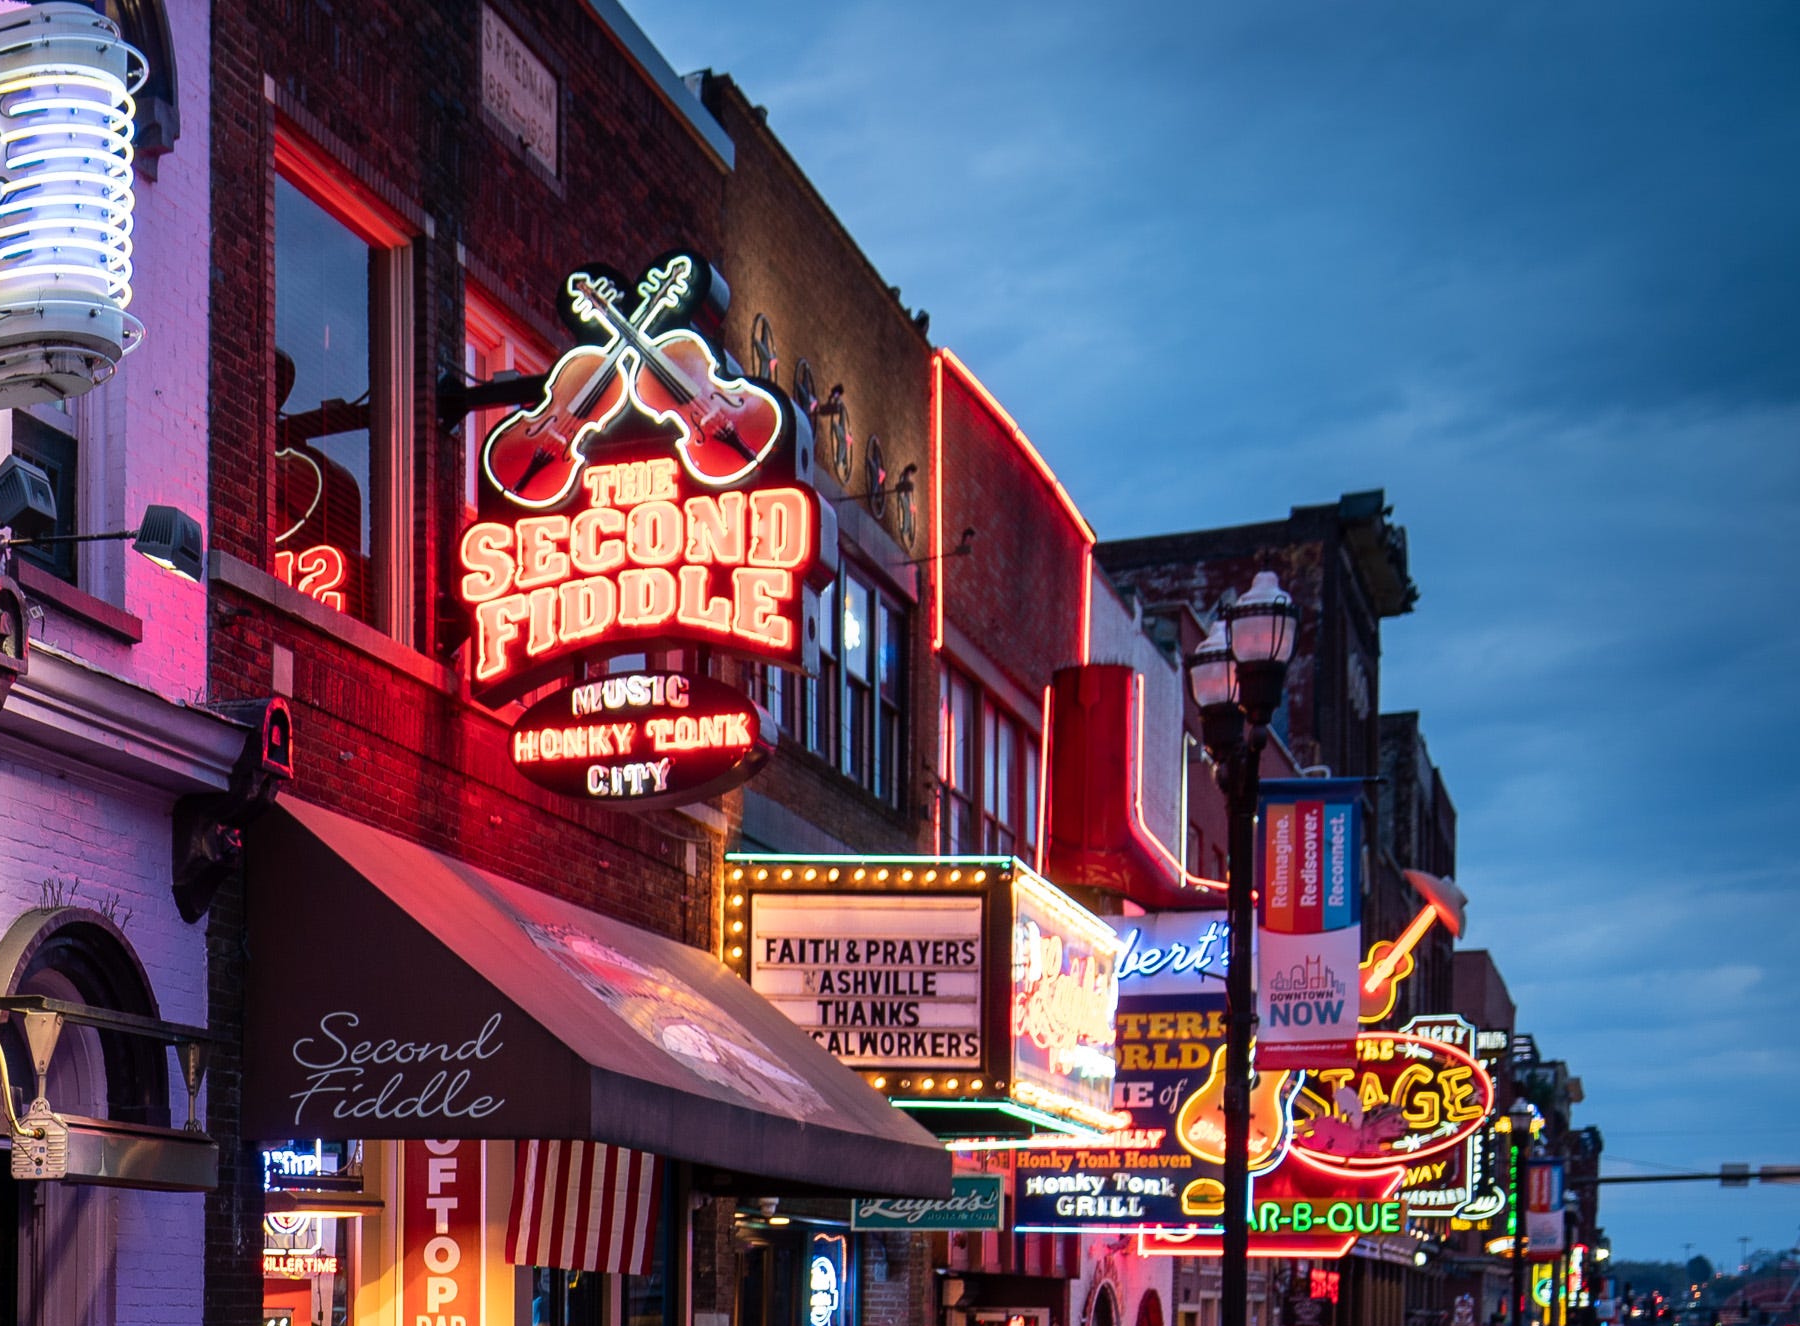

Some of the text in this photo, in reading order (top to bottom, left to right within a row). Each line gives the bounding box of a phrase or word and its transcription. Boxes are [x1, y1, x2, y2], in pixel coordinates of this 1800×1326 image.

[583, 457, 679, 507] THE
[460, 487, 814, 603] SECOND
[474, 564, 793, 683] FIDDLE
[571, 673, 691, 718] MUSIC
[513, 712, 751, 764] HONKY TONK
[588, 756, 671, 798] CITY
[1300, 808, 1319, 908] Rediscover.
[1328, 812, 1346, 908] Reconnect.
[765, 938, 977, 966] FAITH & PRAYERS
[803, 970, 937, 996] NASHVILLE
[1270, 990, 1335, 1003] DOWNTOWN
[817, 1000, 920, 1027] THANKS
[1269, 999, 1345, 1028] NOW
[292, 1011, 503, 1070] Second
[289, 1066, 505, 1126] Fiddle
[1159, 1078, 1189, 1115] of
[1017, 1149, 1192, 1177] Honky Tonk Heaven
[1025, 1171, 1177, 1198] Honky Tonk
[1055, 1194, 1145, 1218] GRILL
[305, 1256, 338, 1274] TIME
